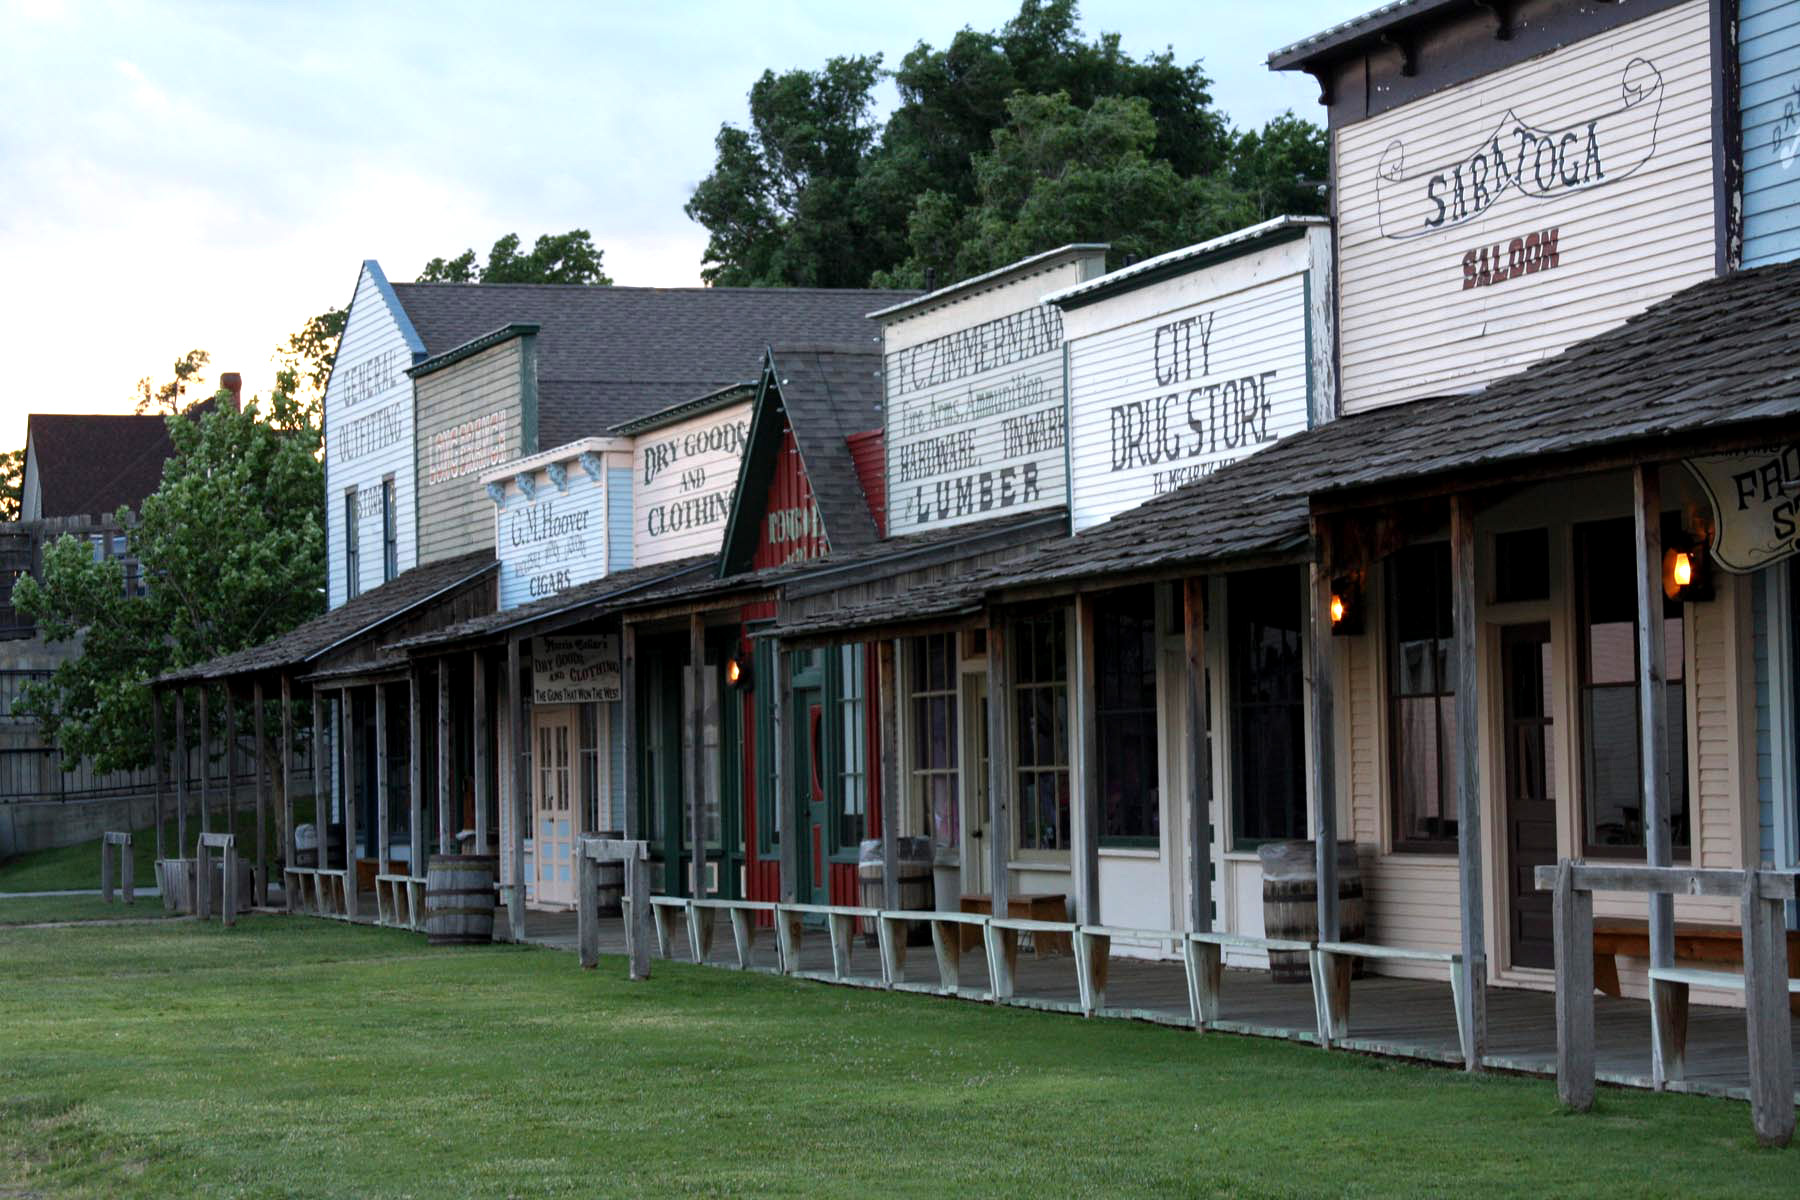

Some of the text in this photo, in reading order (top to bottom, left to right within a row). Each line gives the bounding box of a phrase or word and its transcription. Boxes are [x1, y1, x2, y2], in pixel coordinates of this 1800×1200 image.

[1424, 121, 1605, 228] SARATOGA
[1462, 227, 1560, 291] SALOON
[343, 350, 397, 407] GENERAL
[1154, 311, 1215, 387] CITY
[338, 402, 402, 462] OUTFITTING
[1111, 371, 1279, 472] DRUG STORE
[643, 421, 749, 486] DRY GOODS
[679, 467, 706, 494] AND
[357, 484, 383, 519] STORE
[916, 462, 1040, 524] LUMBER
[530, 569, 572, 598] CIGARS
